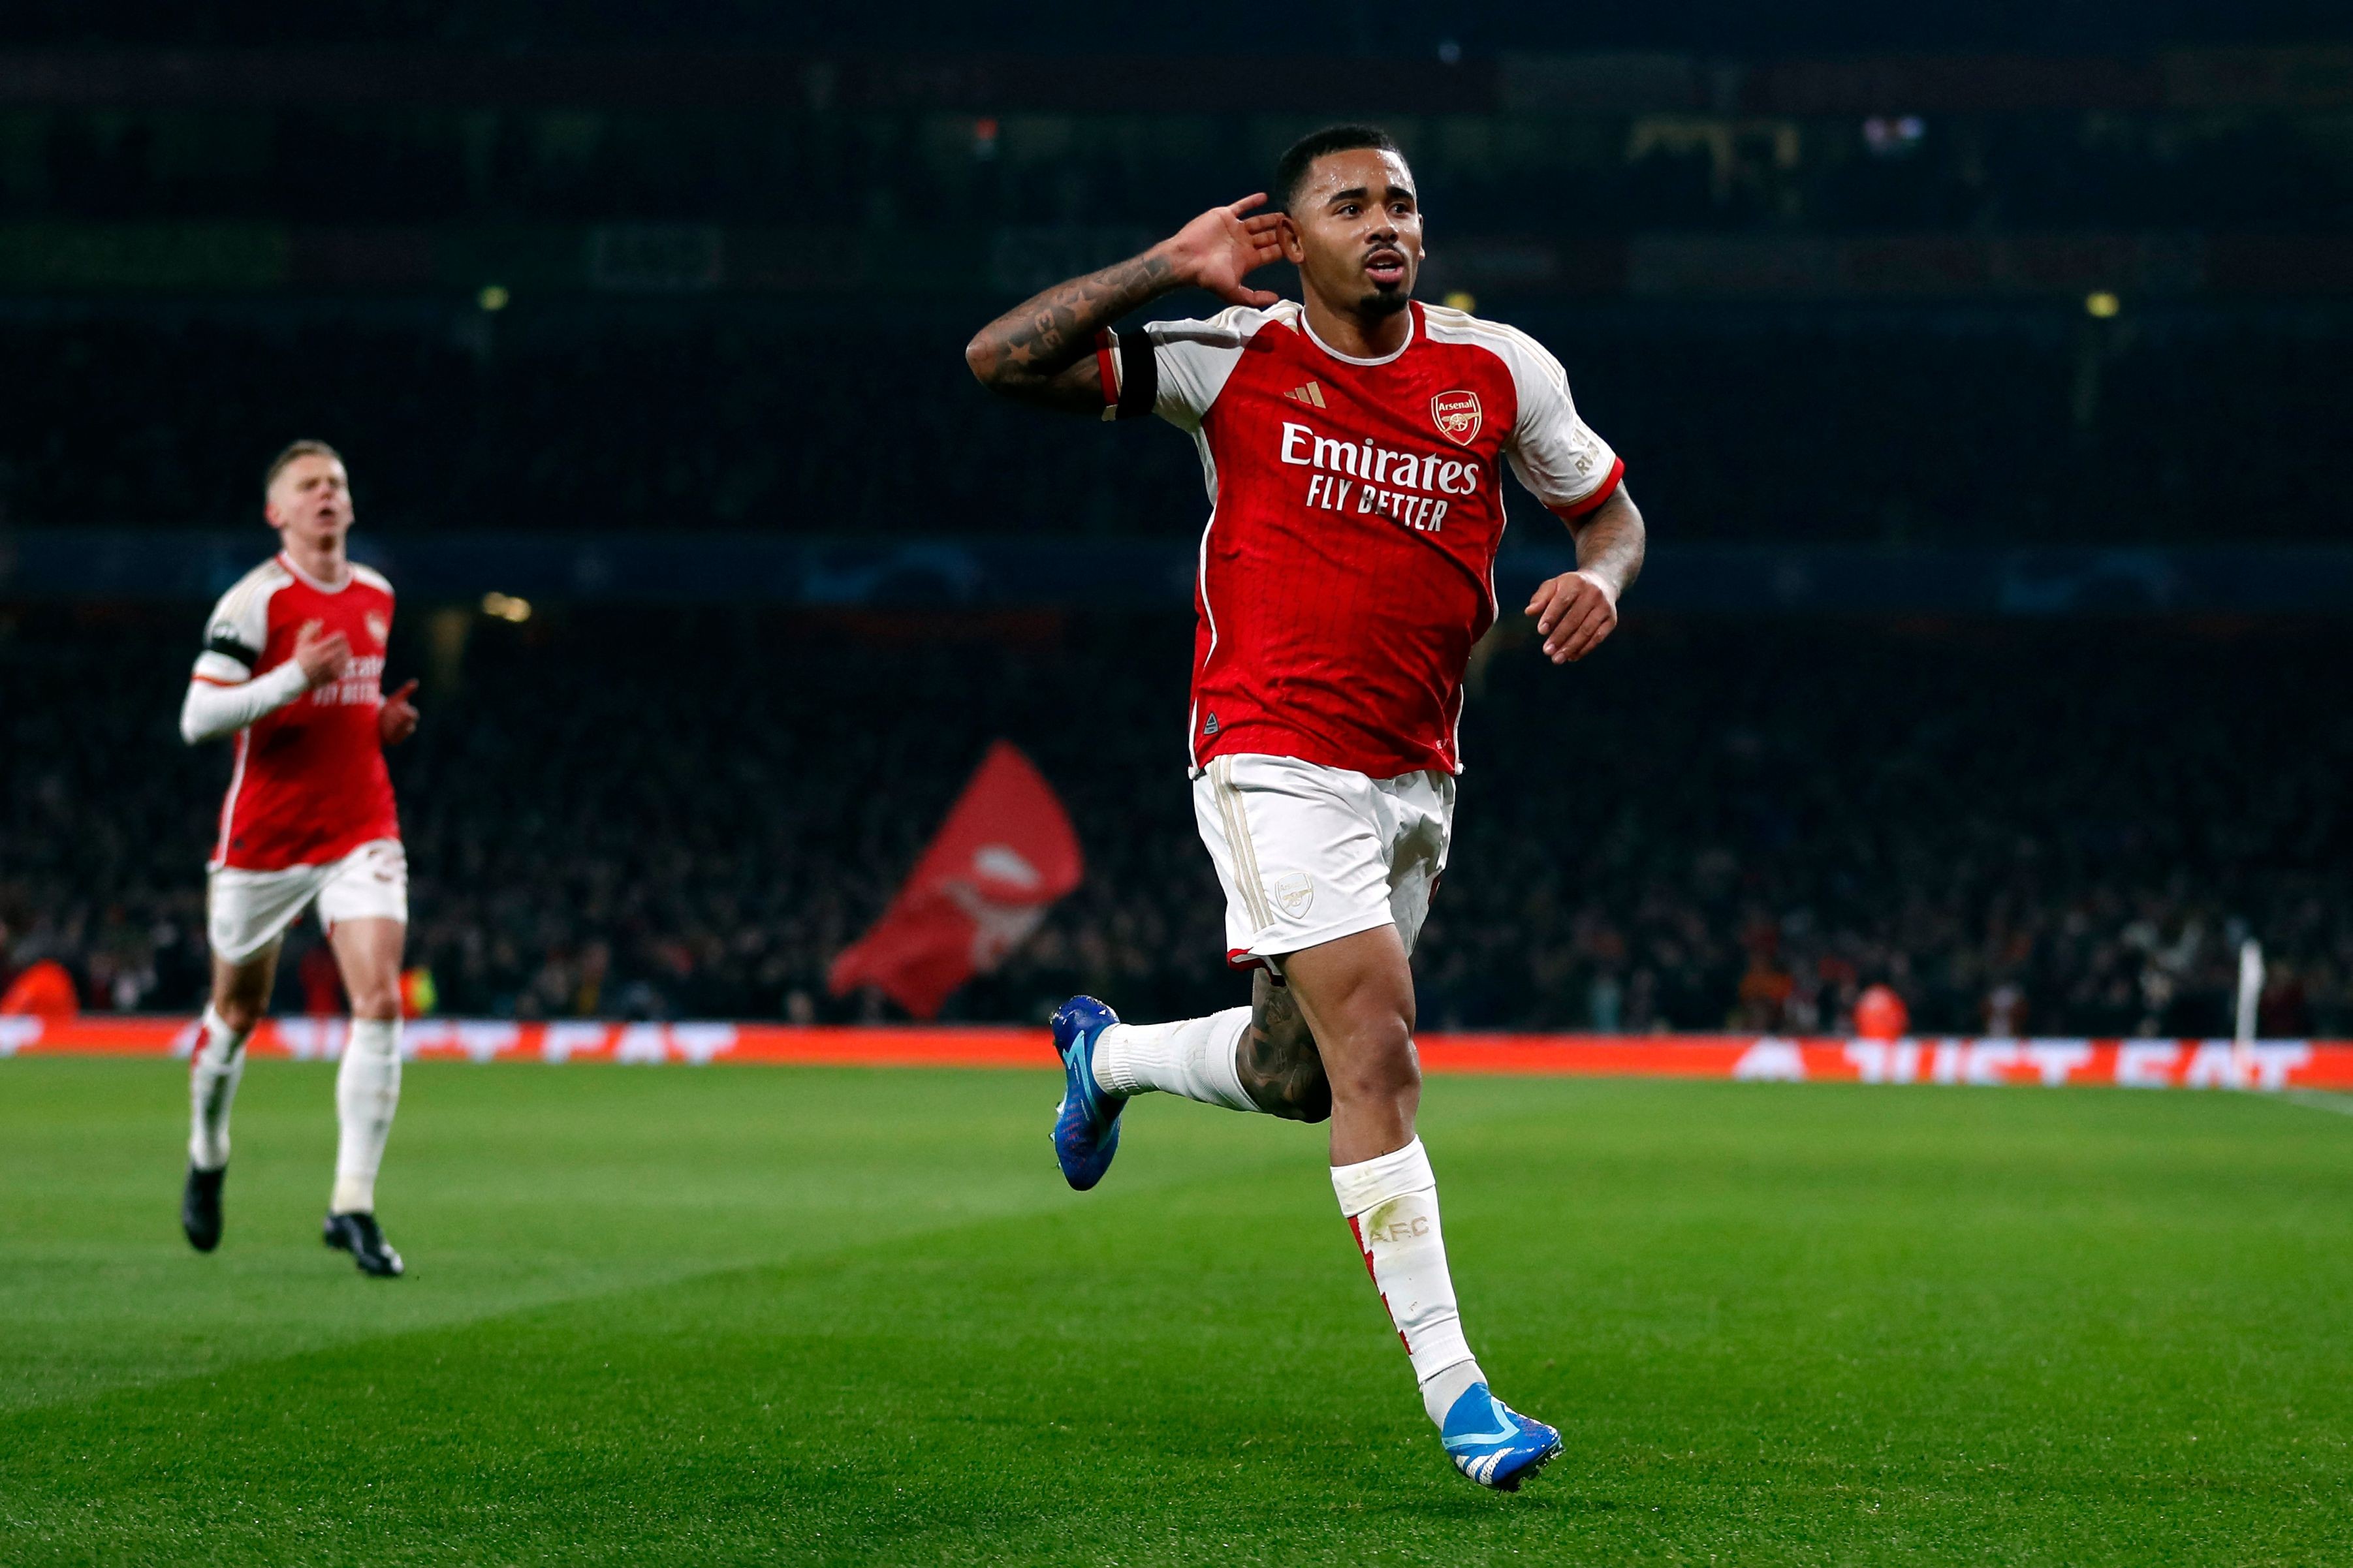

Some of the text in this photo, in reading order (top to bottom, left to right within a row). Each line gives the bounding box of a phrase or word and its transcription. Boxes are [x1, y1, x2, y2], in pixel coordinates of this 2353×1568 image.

[1438, 399, 1473, 411] Arsenal
[1281, 422, 1479, 495] Emirates
[1306, 475, 1448, 531] FLY BETTER
